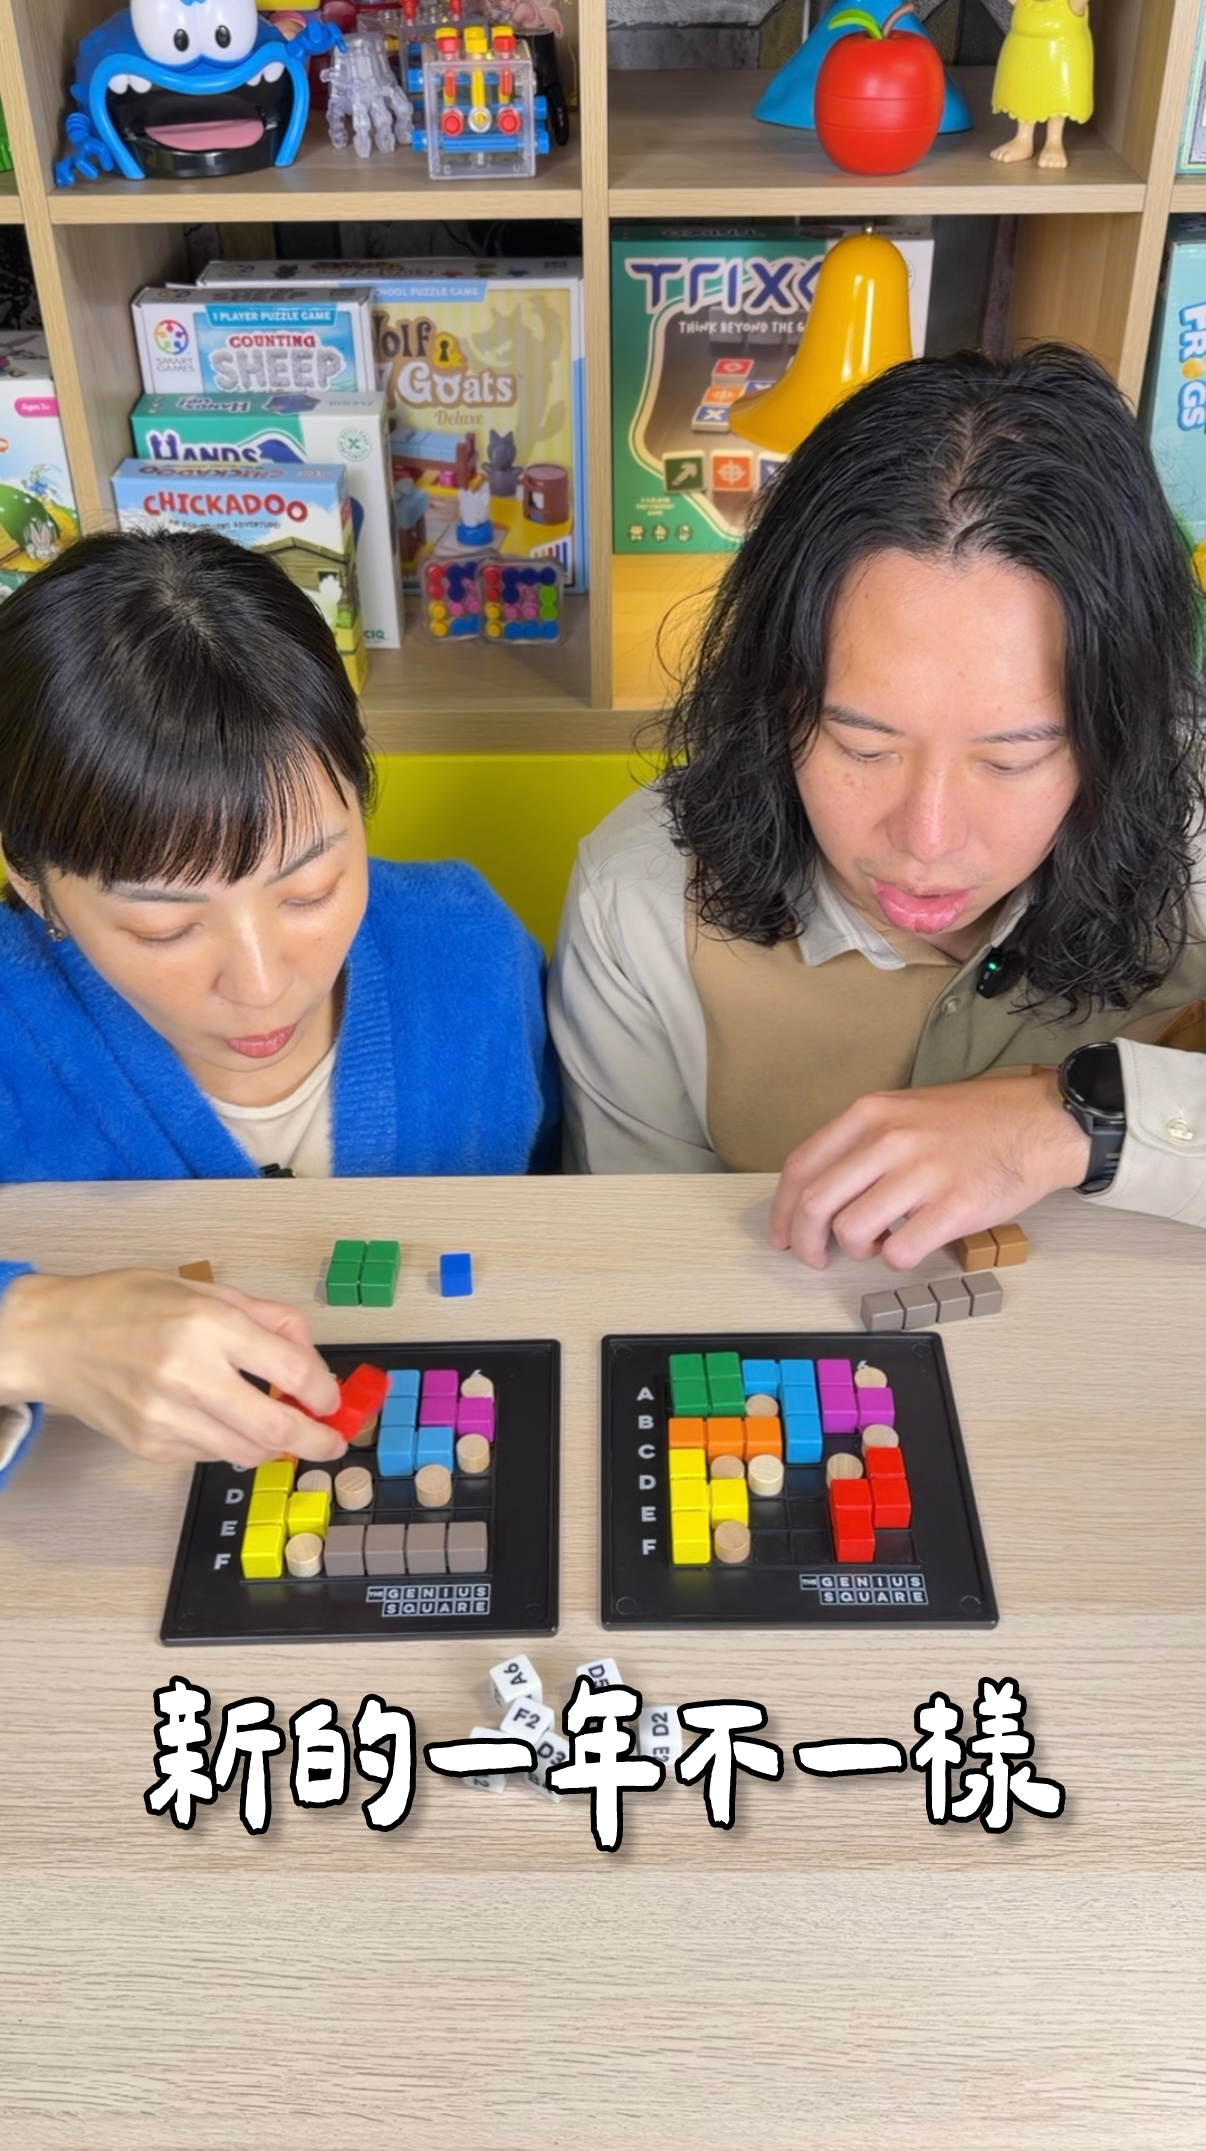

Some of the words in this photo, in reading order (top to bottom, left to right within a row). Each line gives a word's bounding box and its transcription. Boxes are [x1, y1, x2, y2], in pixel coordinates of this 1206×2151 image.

[450, 287, 479, 297] GAME
[213, 312, 218, 321] 1
[219, 311, 258, 322] PLAYER
[260, 311, 299, 321] PUZZLE
[300, 311, 331, 321] GAME
[772, 321, 794, 333] THE
[229, 335, 316, 348] COUNTING
[211, 349, 343, 390] SHEEP
[397, 361, 512, 404] Goats
[434, 410, 484, 426] Deluxe
[143, 491, 308, 522] CHICKADOO
[637, 1386, 654, 1401] A
[638, 1415, 654, 1429] B
[638, 1444, 656, 1459] C
[639, 1475, 657, 1490] D
[225, 1488, 245, 1504] D
[641, 1506, 657, 1522] E
[220, 1520, 238, 1536] E
[642, 1539, 657, 1555] F
[213, 1553, 231, 1570] F
[821, 1577, 921, 1588] GENIUS
[387, 1586, 487, 1599] GENIUS
[823, 1591, 924, 1603] SQUARE
[386, 1601, 486, 1615] SQUARE
[503, 1662, 527, 1686] A6
[512, 1707, 541, 1730] F2
[651, 1712, 669, 1737] D2
